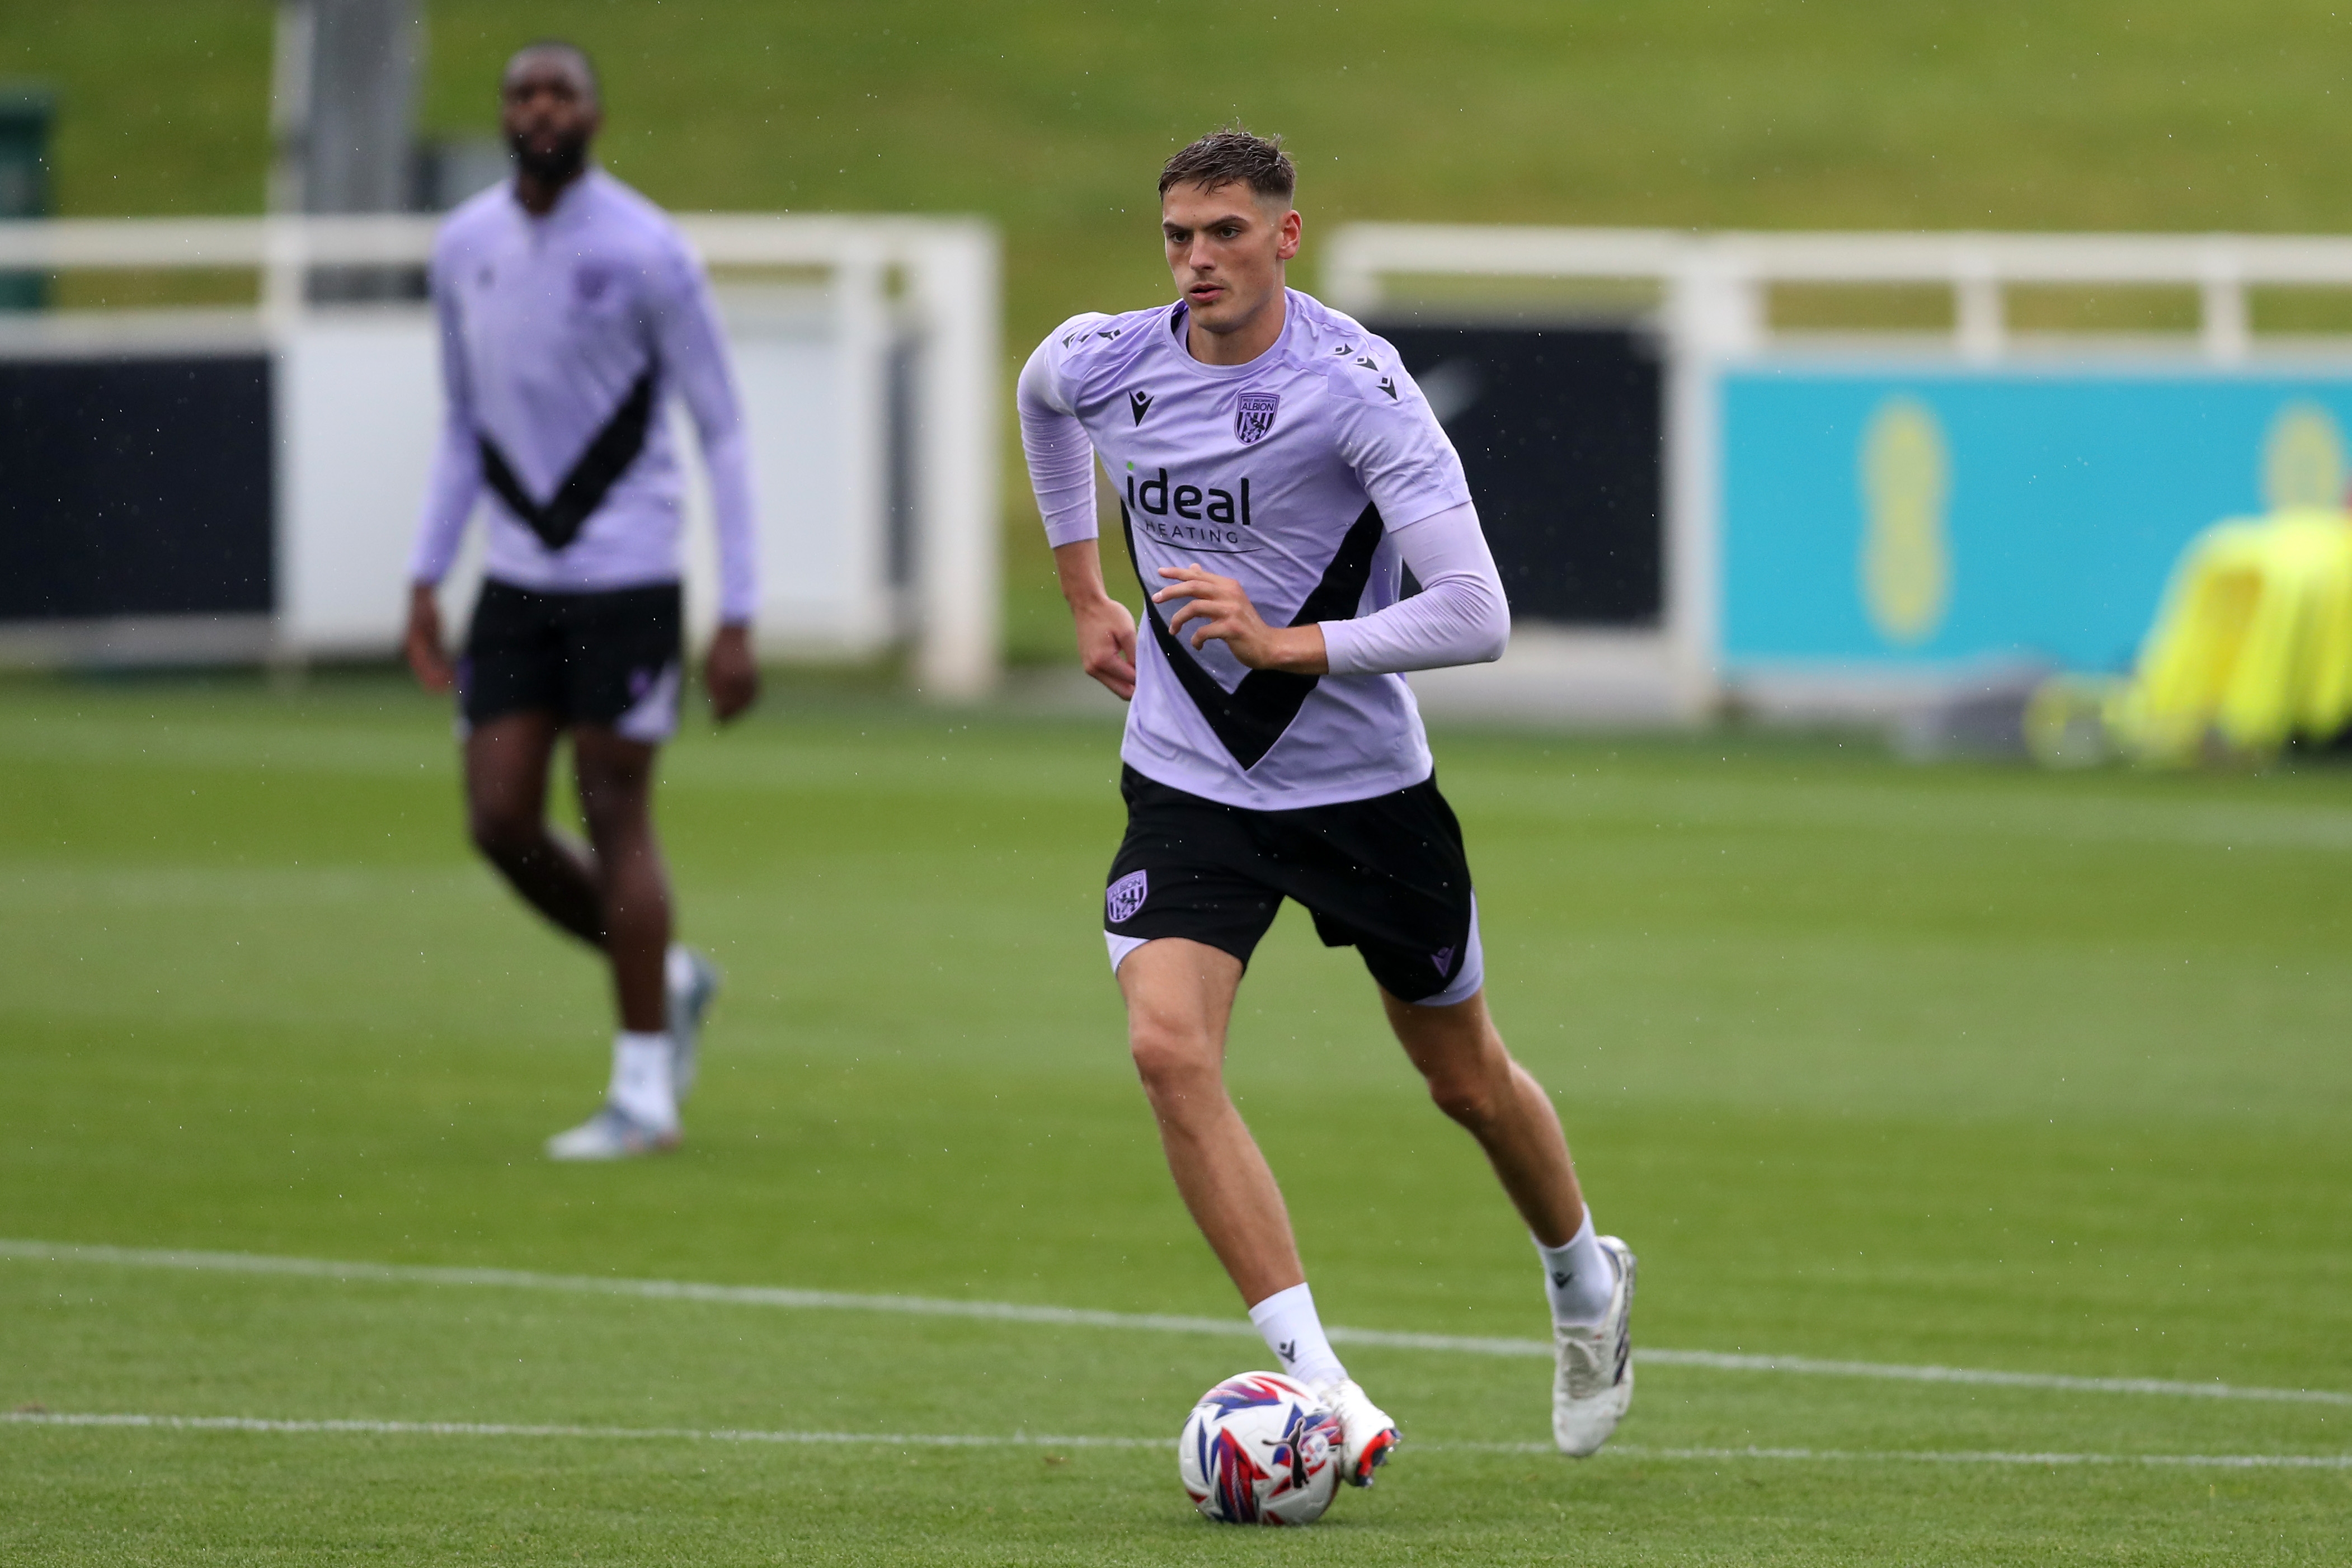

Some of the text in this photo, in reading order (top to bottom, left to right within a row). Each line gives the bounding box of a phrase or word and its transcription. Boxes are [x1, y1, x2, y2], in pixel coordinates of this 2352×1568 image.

[1241, 402, 1274, 411] ALBION
[1126, 461, 1250, 525] ideal
[1145, 520, 1238, 544] HEATING
